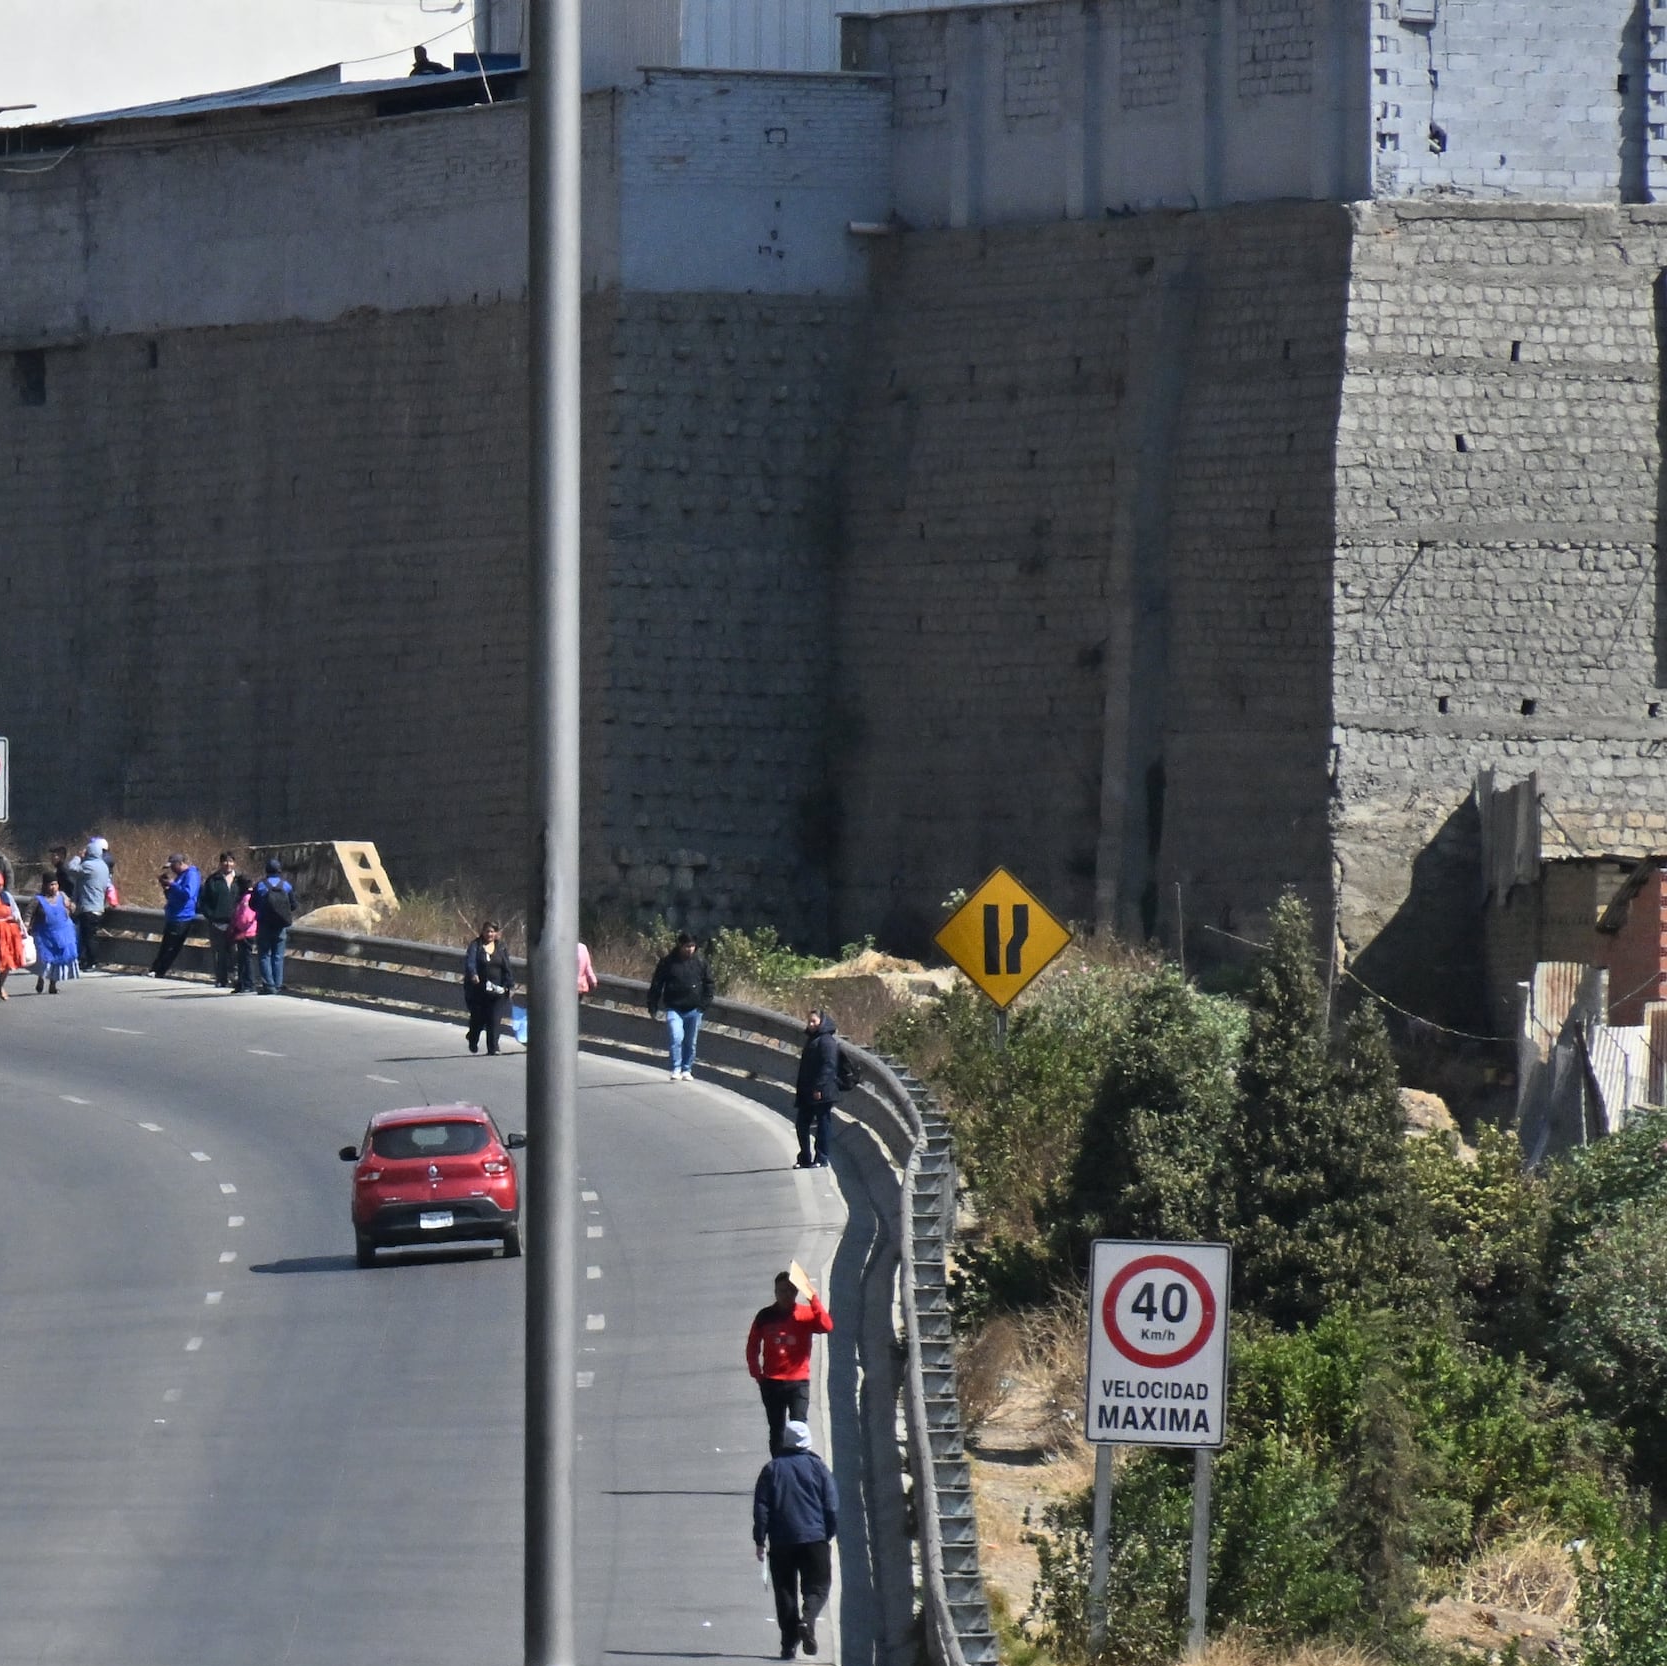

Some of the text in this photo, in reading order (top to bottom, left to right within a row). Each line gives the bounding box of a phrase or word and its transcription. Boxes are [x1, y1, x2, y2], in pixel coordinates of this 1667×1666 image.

[1131, 1282, 1188, 1323] 40
[1141, 1329, 1176, 1341] Km/h
[1102, 1379, 1209, 1400] VELOCIDAD
[1098, 1404, 1210, 1433] MAXIMA
